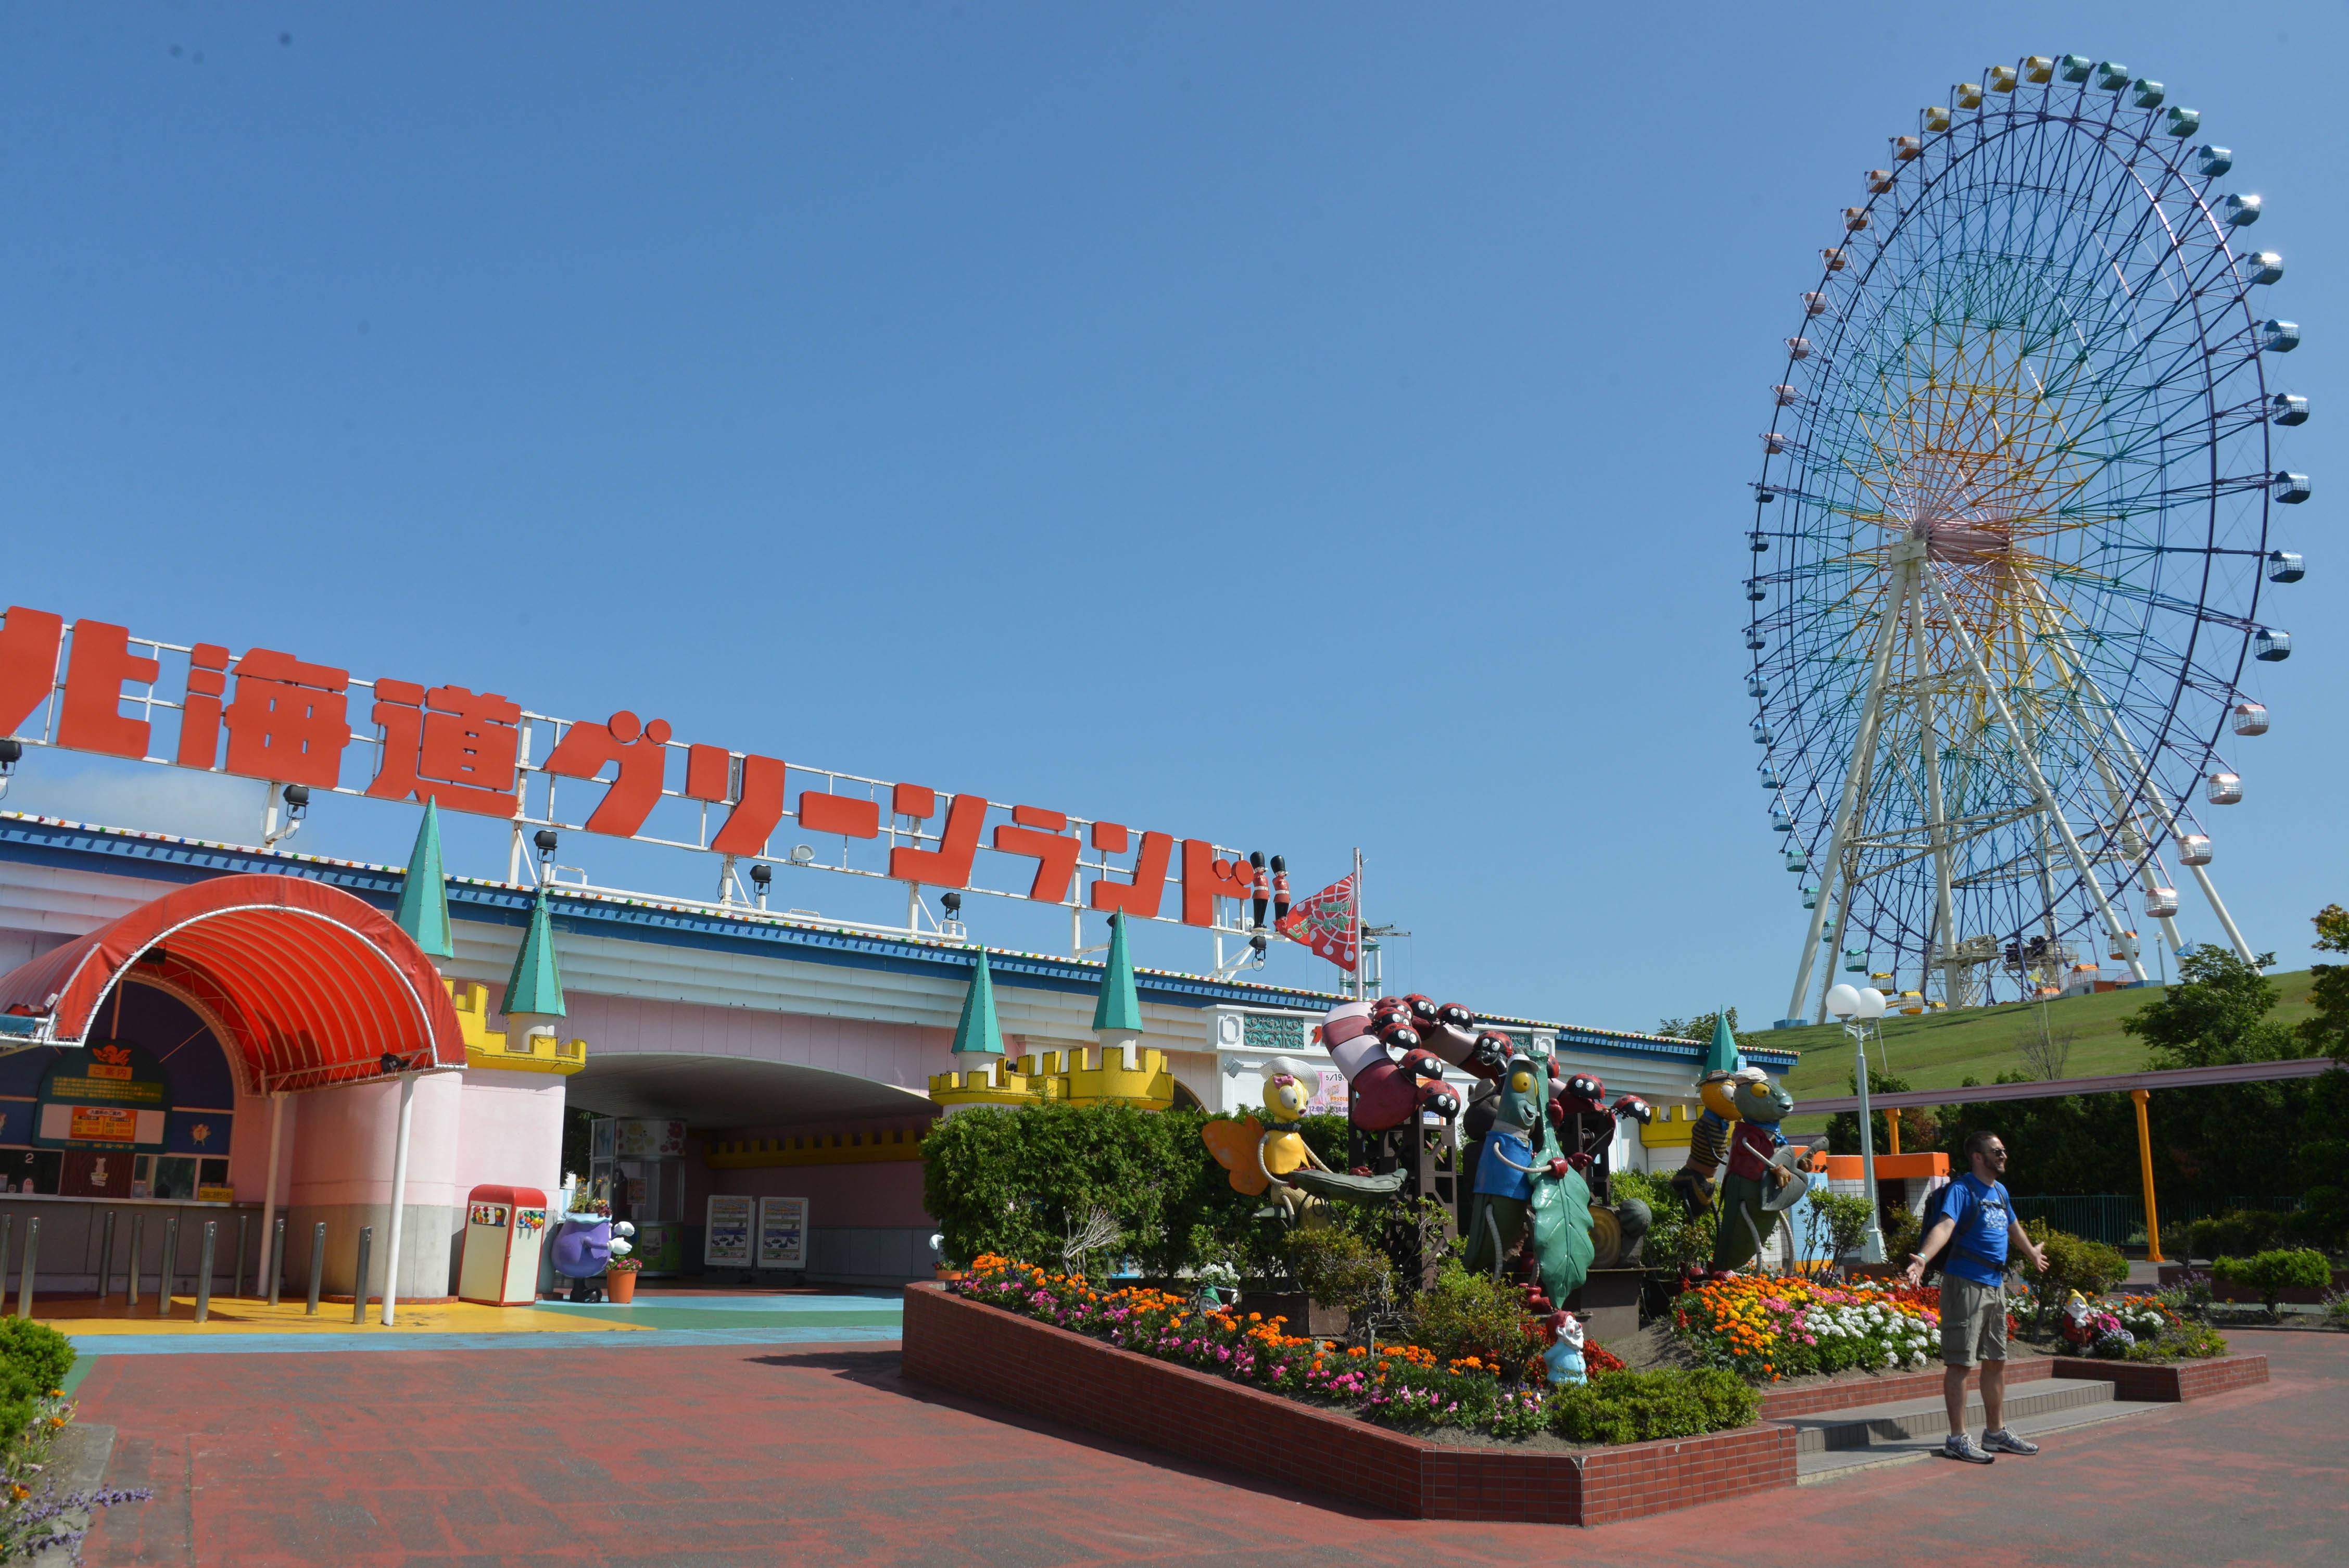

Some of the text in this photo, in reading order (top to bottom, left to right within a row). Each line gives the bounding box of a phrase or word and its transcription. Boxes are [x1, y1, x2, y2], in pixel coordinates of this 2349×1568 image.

[93, 1067, 127, 1076] ご案内
[25, 1153, 34, 1164] 2
